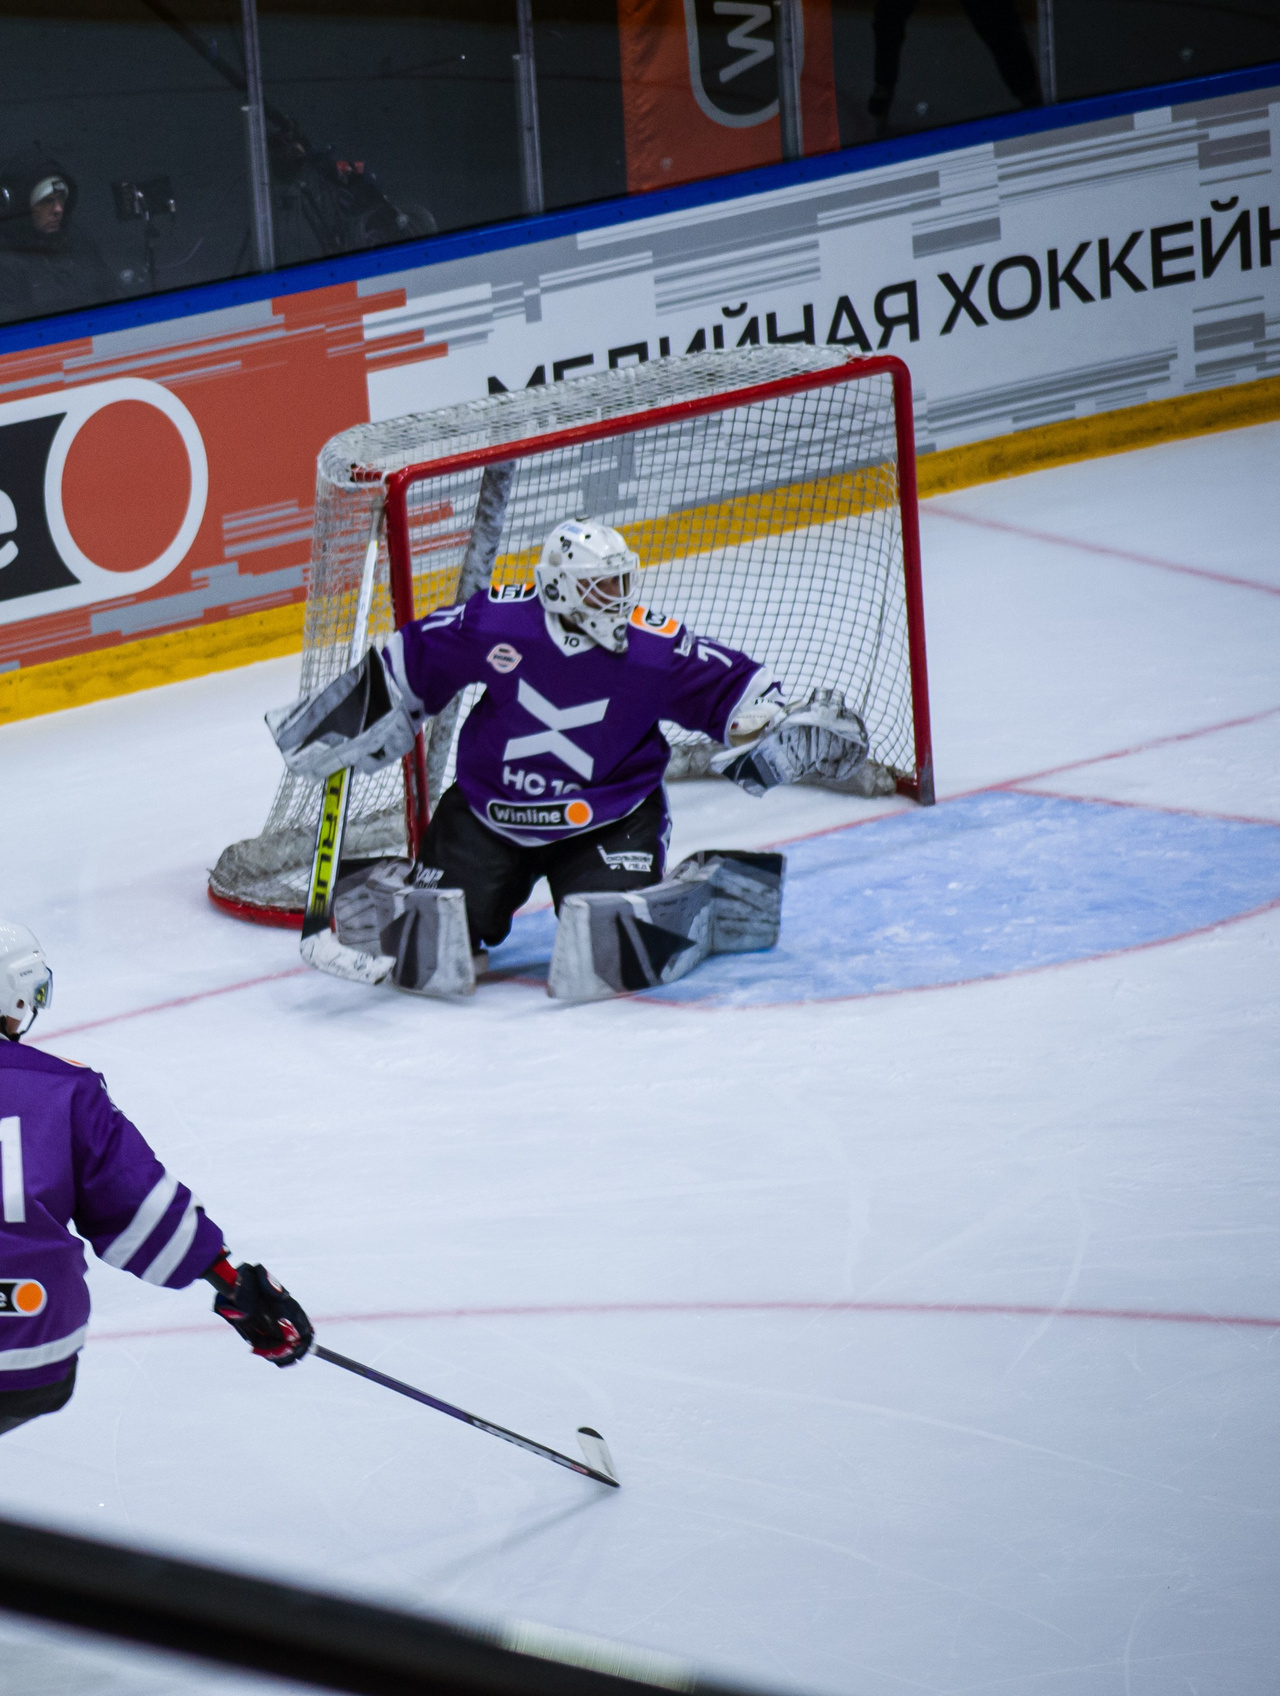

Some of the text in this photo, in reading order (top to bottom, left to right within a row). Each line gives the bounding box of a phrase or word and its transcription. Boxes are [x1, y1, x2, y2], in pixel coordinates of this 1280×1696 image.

[488, 280, 920, 393] ЙНАЯ
[563, 635, 580, 648] 10
[502, 765, 547, 796] HC
[494, 806, 562, 824] Winline
